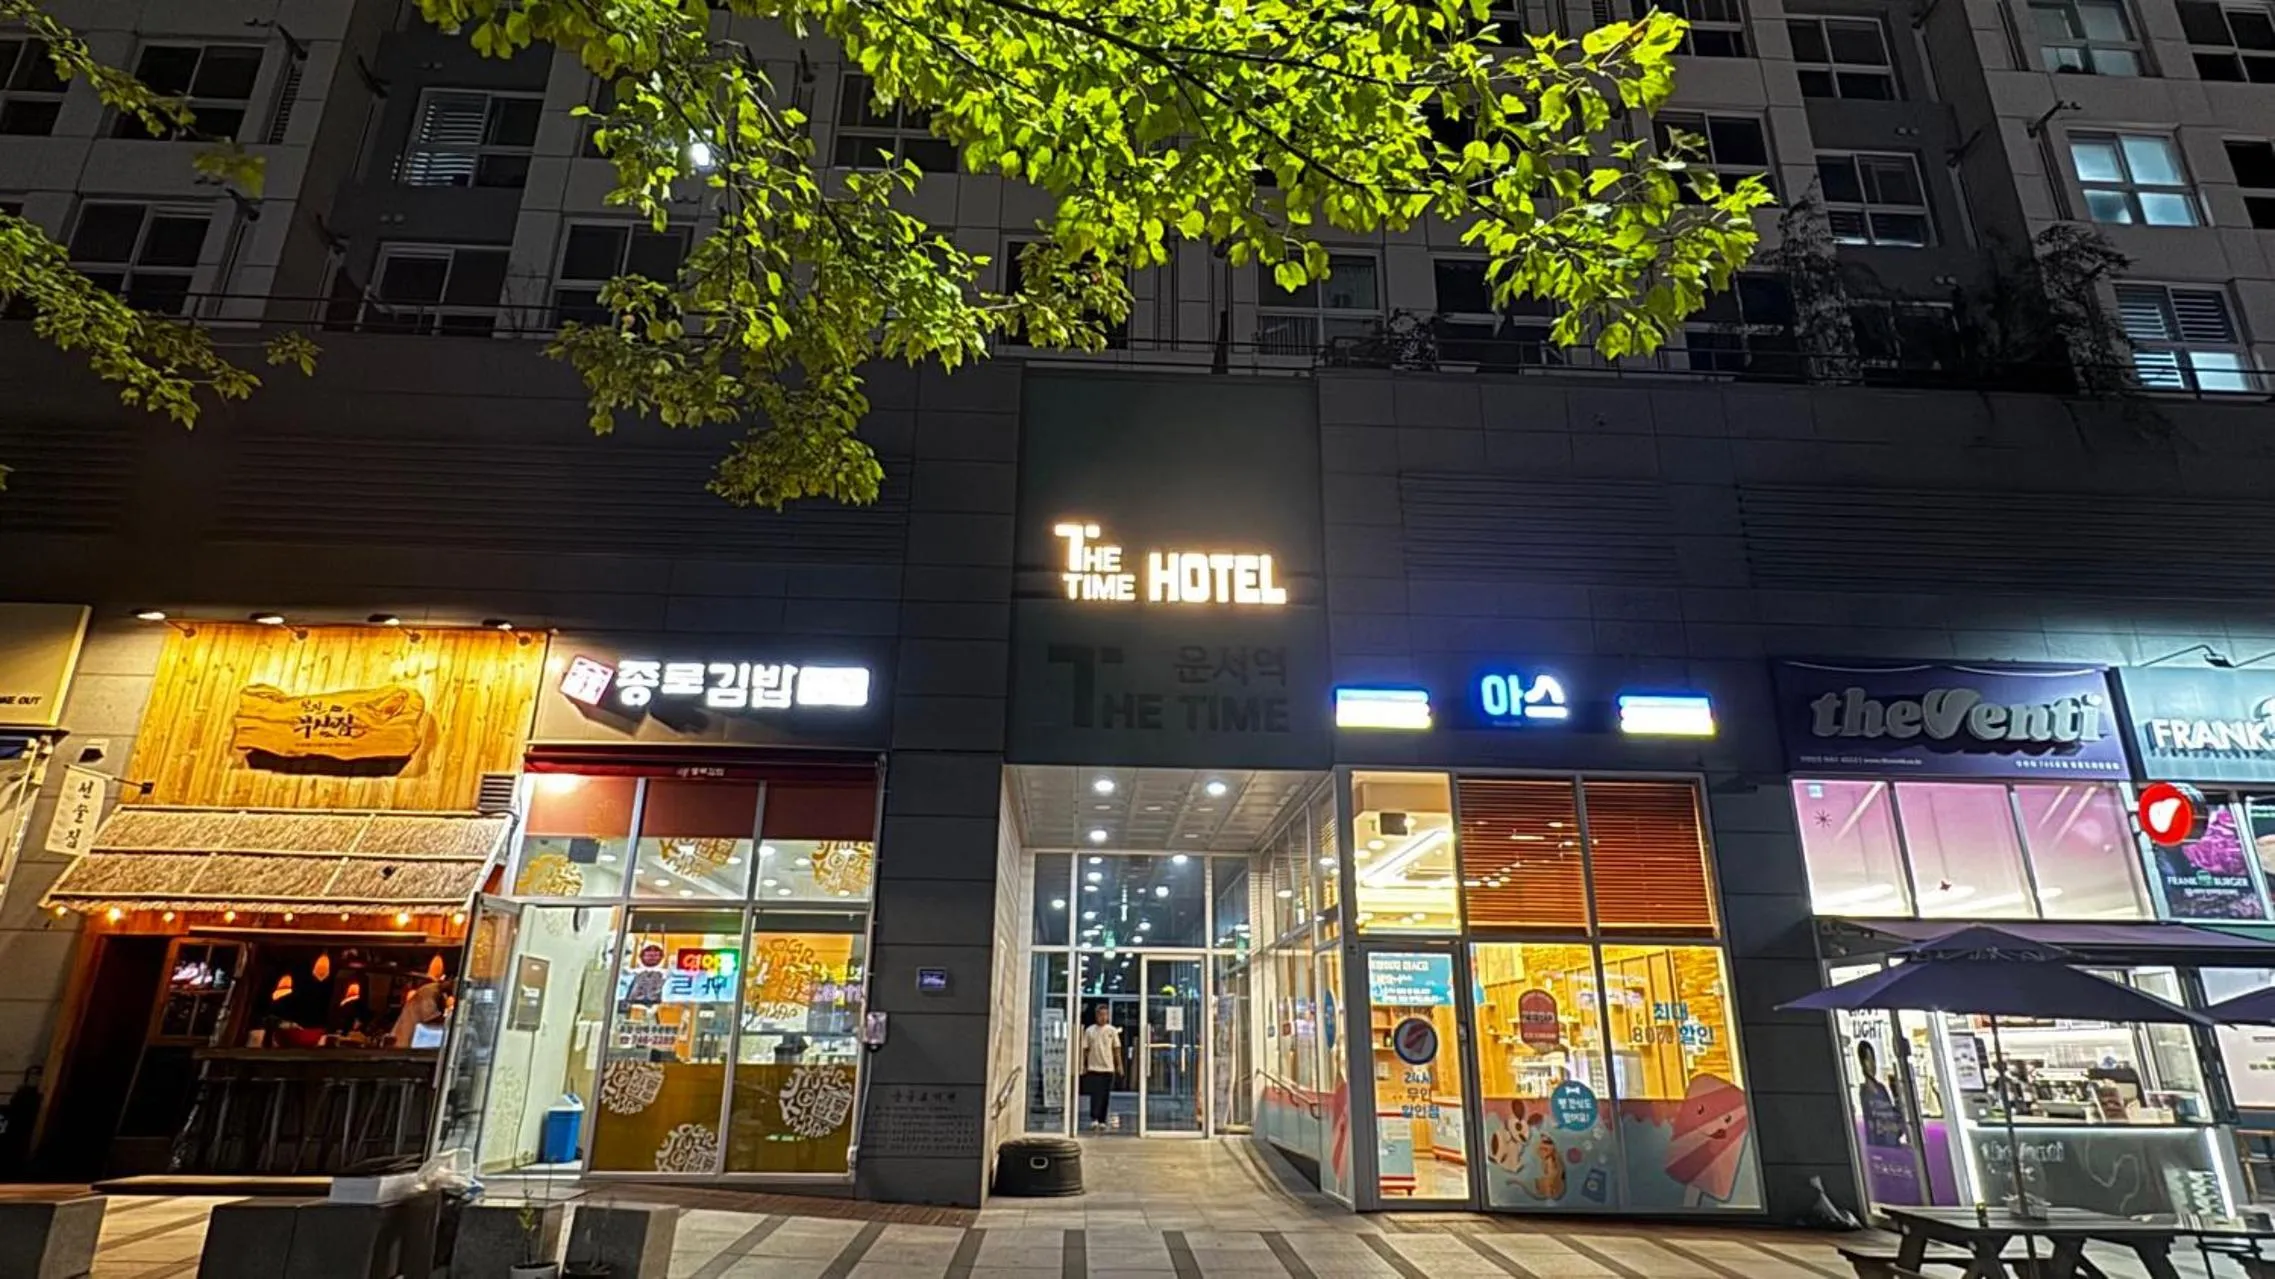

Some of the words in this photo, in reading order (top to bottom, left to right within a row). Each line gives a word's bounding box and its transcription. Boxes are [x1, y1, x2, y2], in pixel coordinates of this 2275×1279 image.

[1055, 524, 1122, 572] THE
[1063, 574, 1136, 601] TIME
[1149, 553, 1287, 604] HOTEL
[616, 660, 798, 709] 종로김밥
[1048, 644, 1164, 730] THE
[1177, 694, 1291, 733] TIME
[1173, 646, 1287, 687] 운서역
[18, 695, 42, 705] OUT
[1481, 674, 1569, 718] 아스
[1811, 687, 2104, 743] theVenti
[65, 781, 94, 849] 선술집
[2167, 876, 2198, 886] FRANK
[1653, 1002, 1688, 1021] 최대
[1632, 1026, 1674, 1045] 80%
[1679, 1025, 1714, 1045] 할인
[1407, 1088, 1433, 1102] 무인
